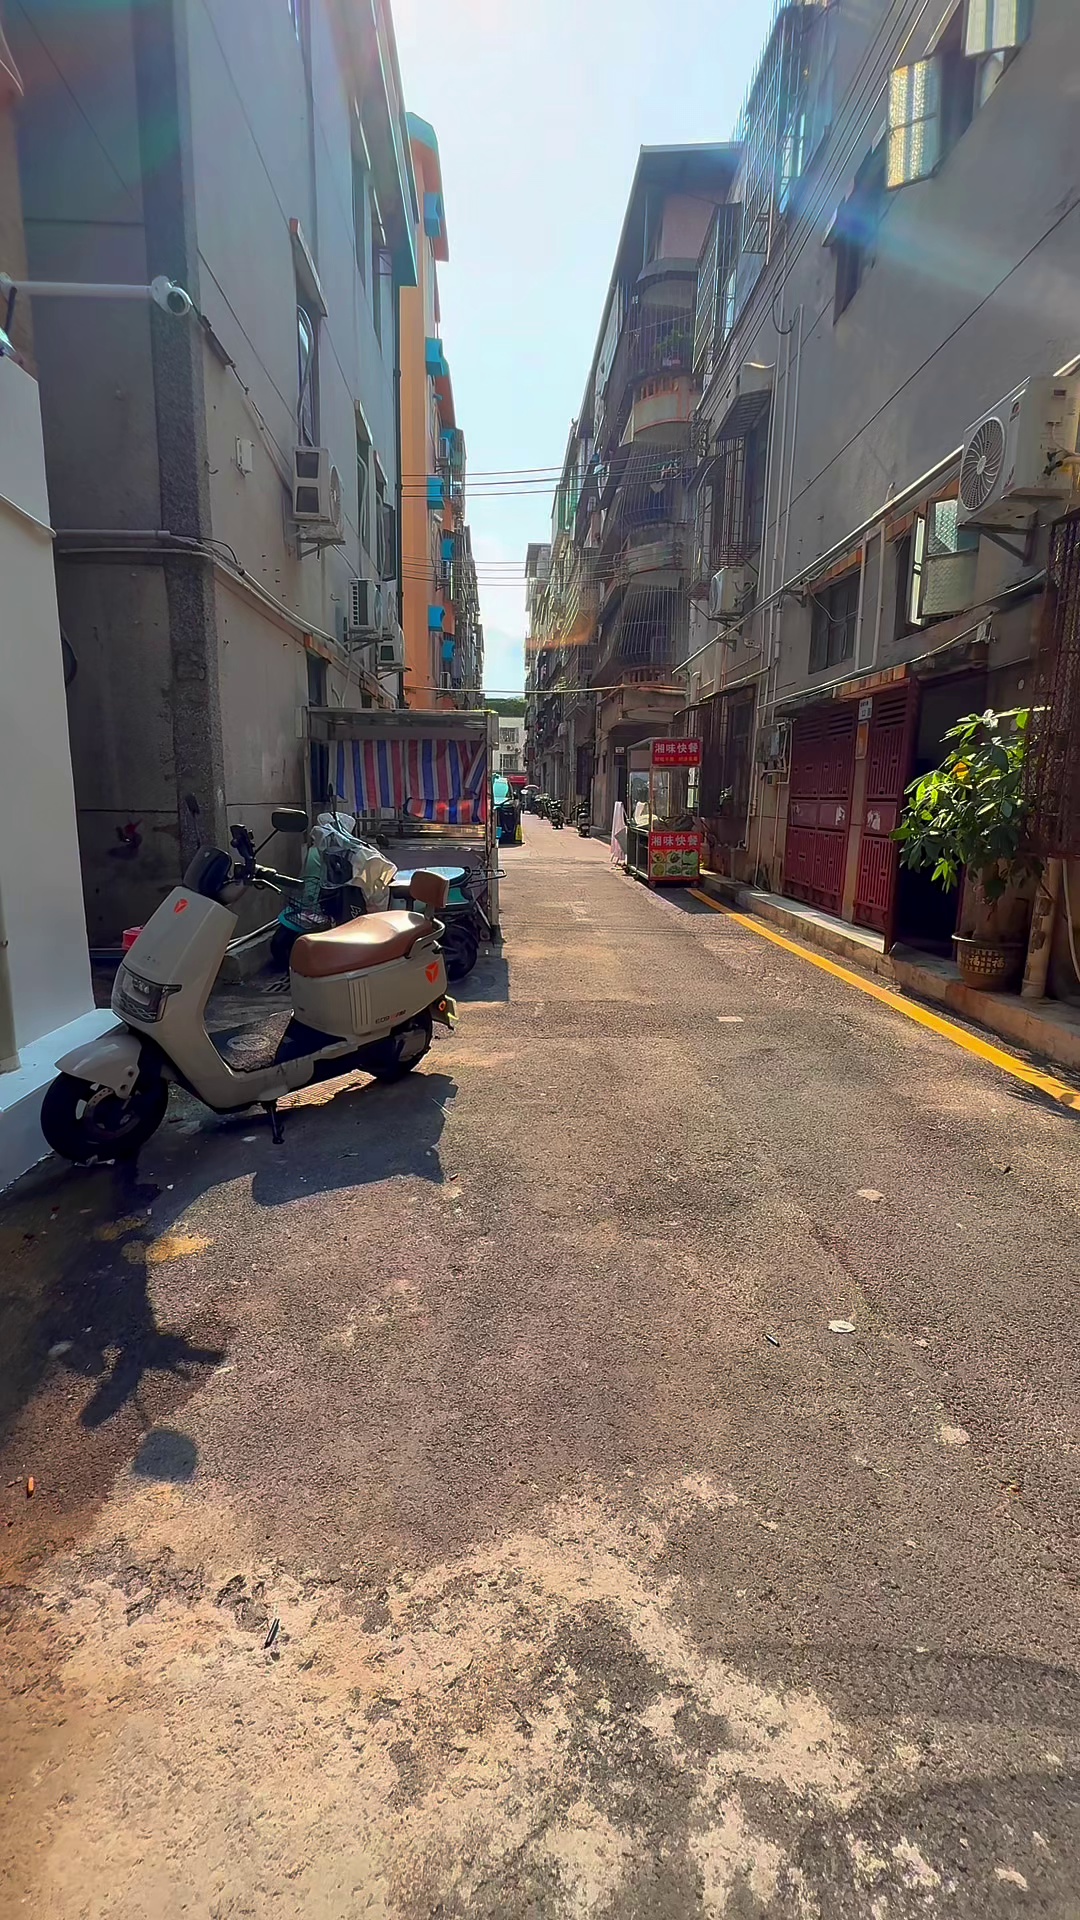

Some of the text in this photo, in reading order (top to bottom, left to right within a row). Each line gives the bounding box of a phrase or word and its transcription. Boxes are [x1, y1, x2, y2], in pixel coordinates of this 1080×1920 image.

[655, 742, 698, 754] 湘味快餐
[650, 835, 698, 847] 湘味快餐
